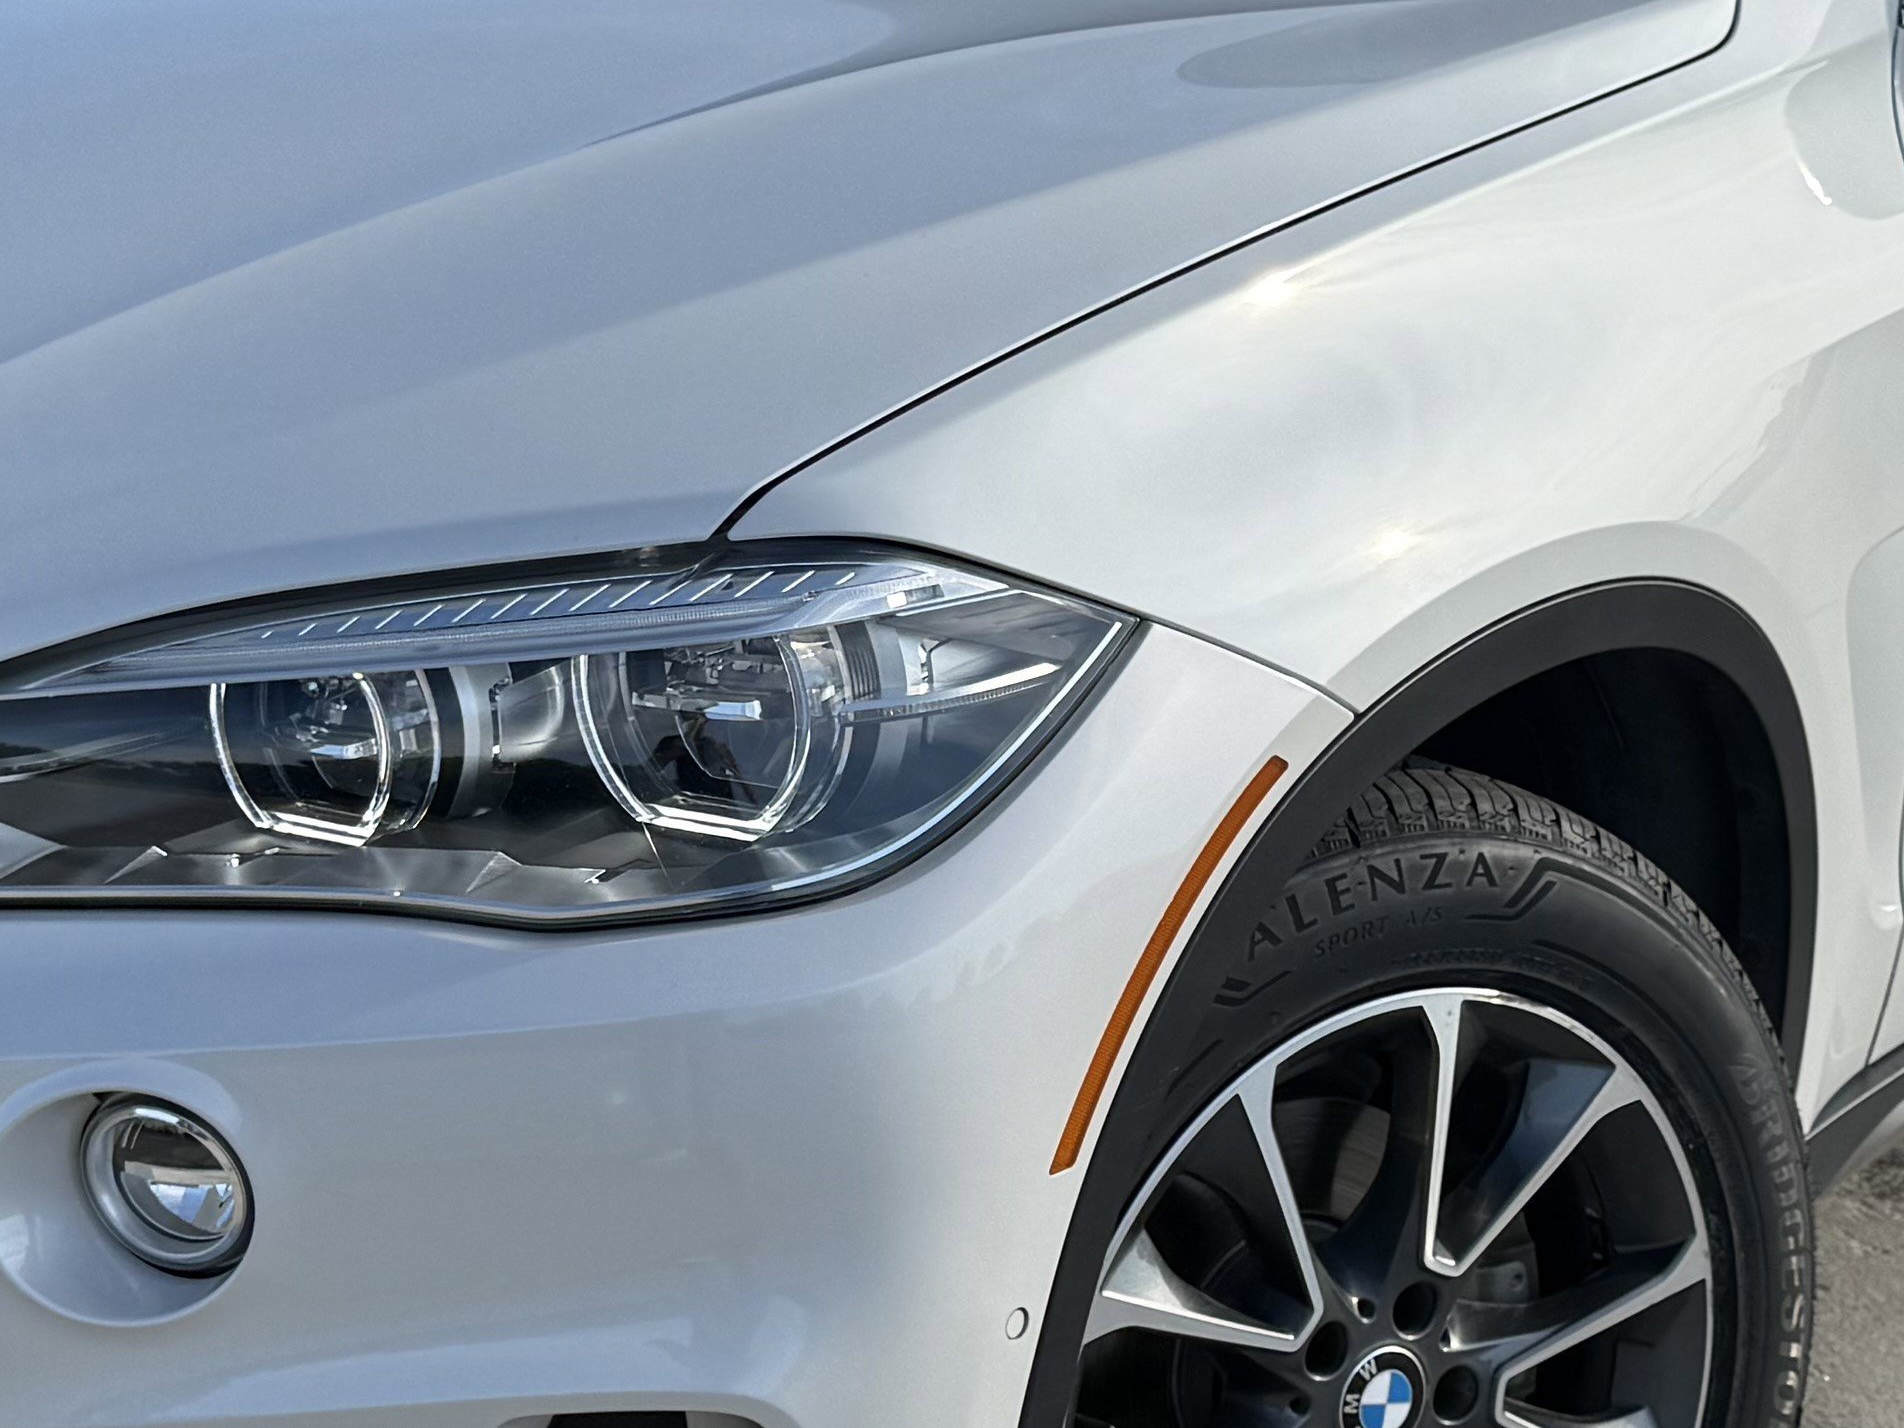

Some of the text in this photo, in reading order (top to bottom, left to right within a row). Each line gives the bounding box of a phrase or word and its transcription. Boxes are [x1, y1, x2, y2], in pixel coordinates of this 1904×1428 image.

[1246, 850, 1499, 963] ALENZA
[1312, 905, 1444, 960] SPORT A/S
